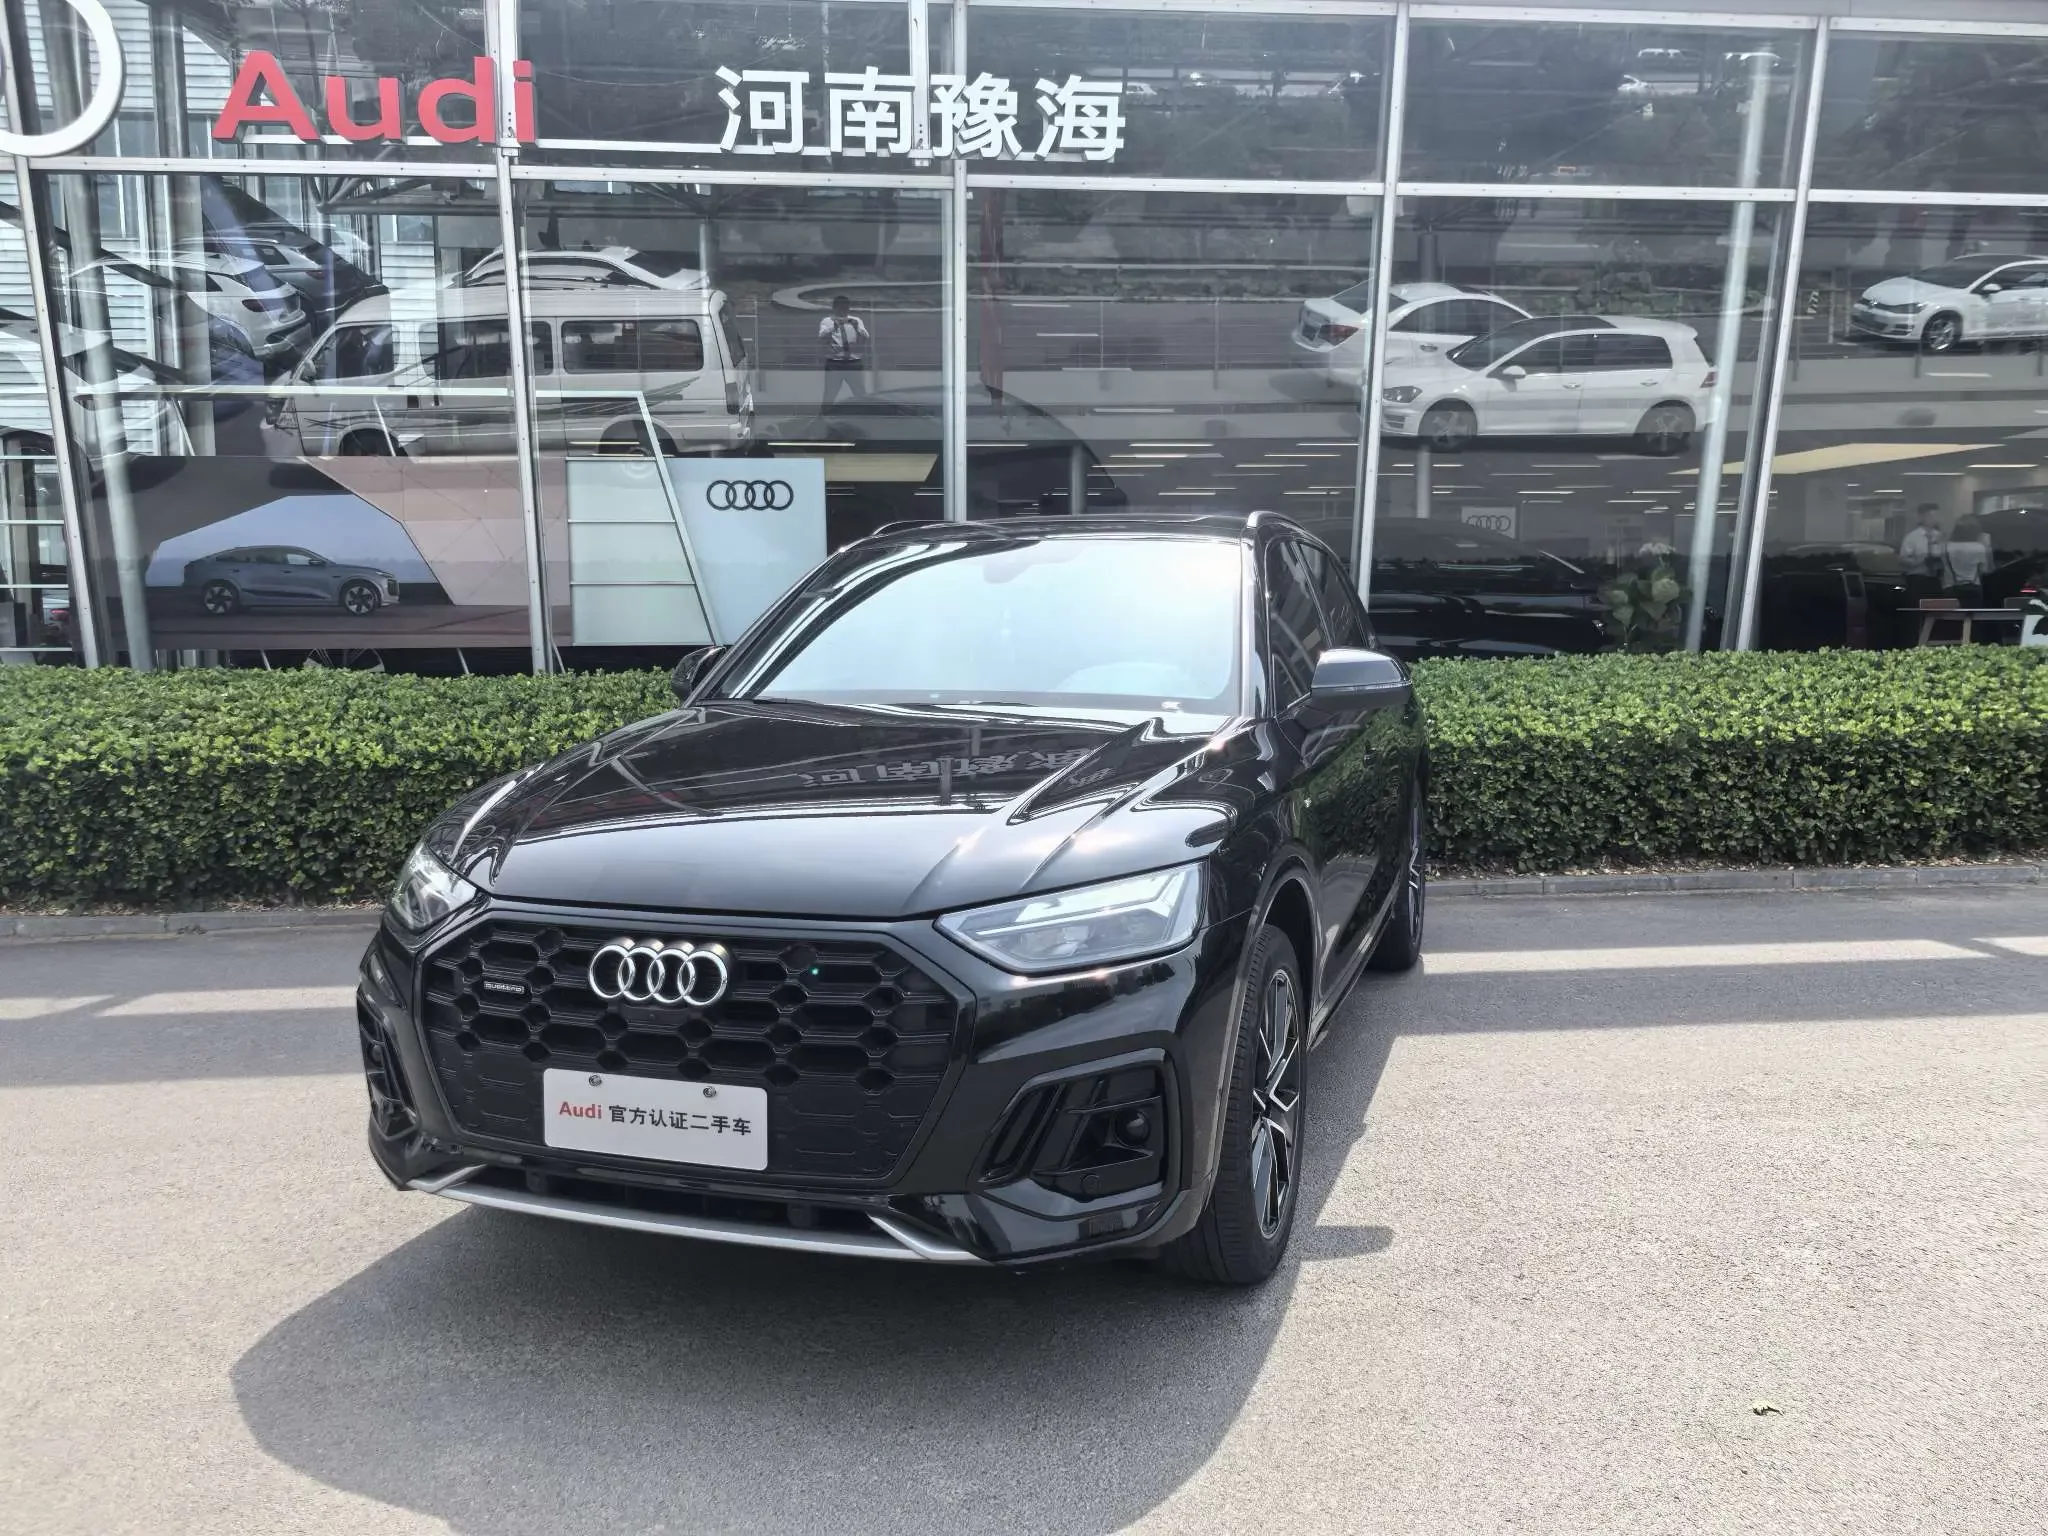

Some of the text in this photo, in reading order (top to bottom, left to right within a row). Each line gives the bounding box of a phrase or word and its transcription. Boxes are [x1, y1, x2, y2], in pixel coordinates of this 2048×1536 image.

[212, 50, 536, 143] Audi
[715, 65, 1126, 160] 河南豫海
[559, 1101, 752, 1136] Audi 官方认证二手车
